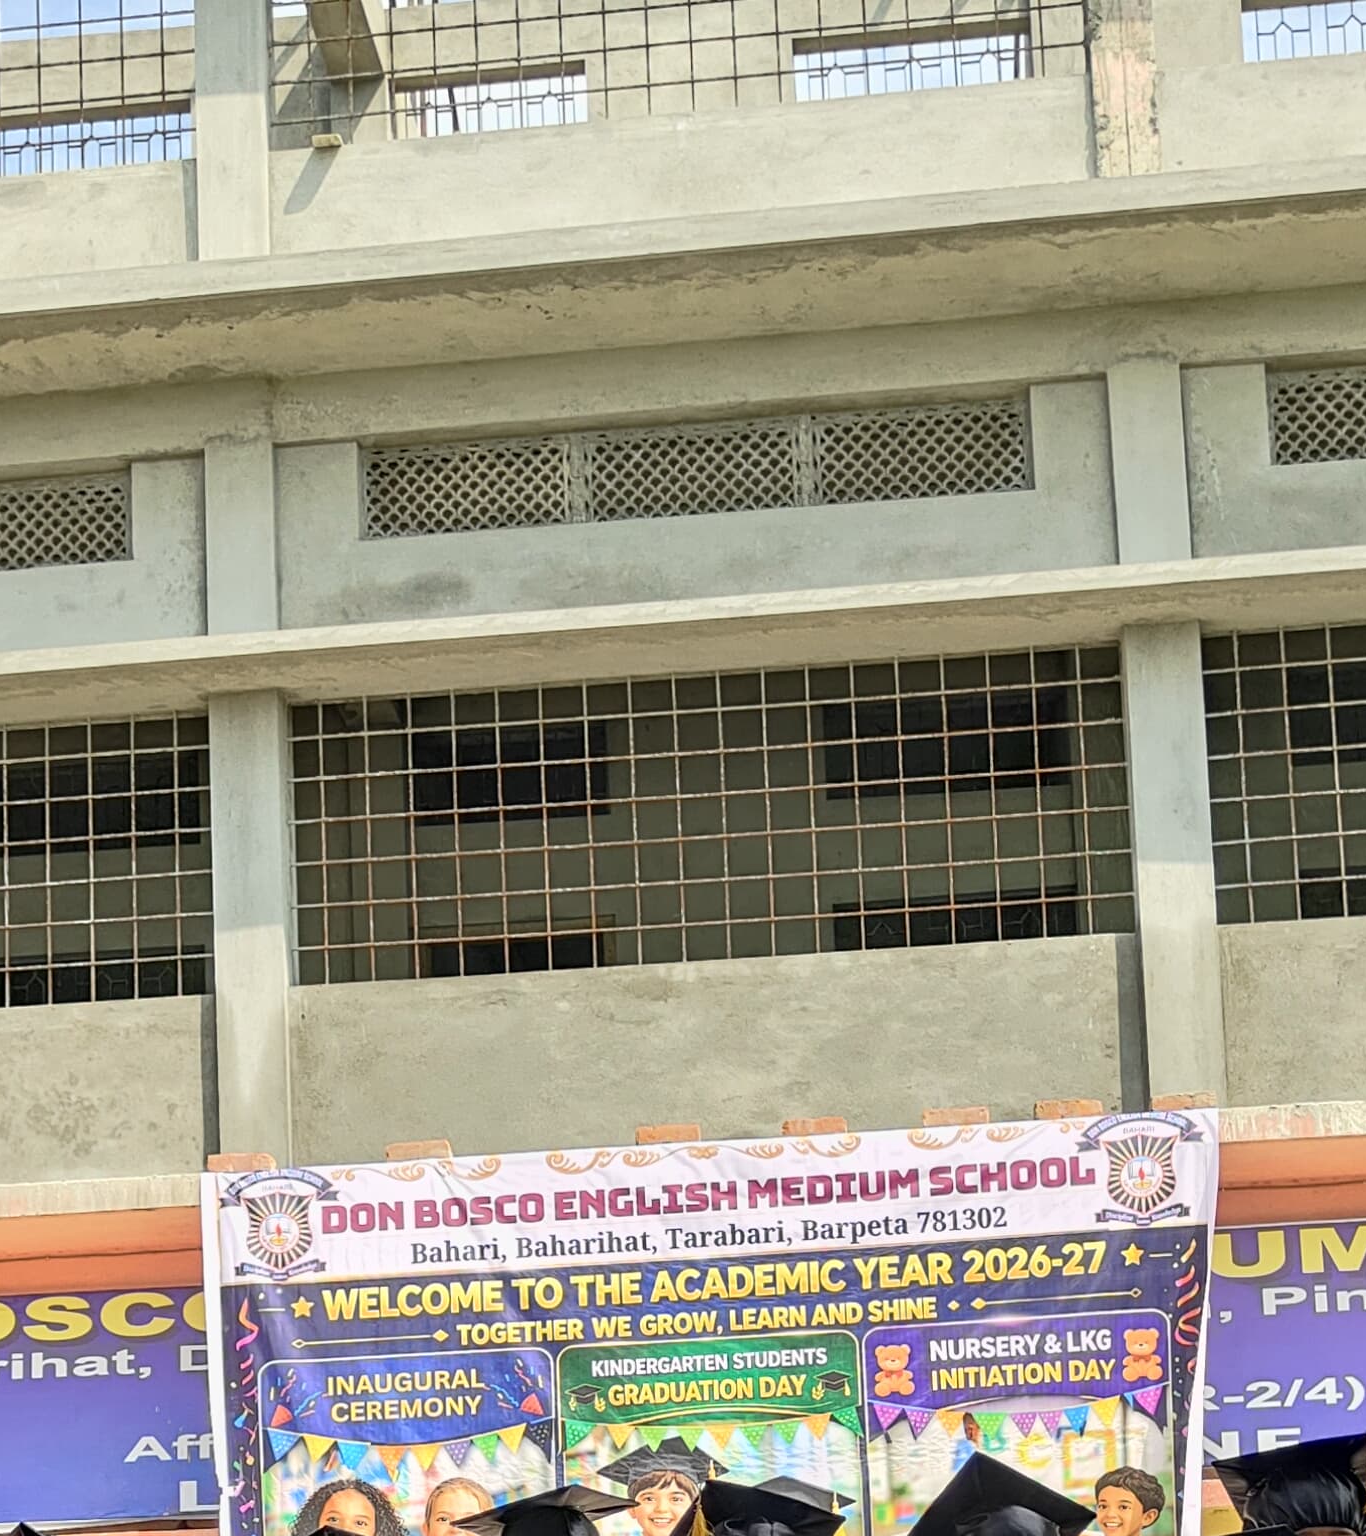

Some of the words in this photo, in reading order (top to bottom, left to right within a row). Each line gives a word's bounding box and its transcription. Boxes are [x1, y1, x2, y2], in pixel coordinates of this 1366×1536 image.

[321, 1200, 405, 1235] DON
[414, 1193, 544, 1229] BOSCO
[554, 1181, 738, 1222] ENGLISH
[747, 1167, 920, 1210] MEDIUM
[929, 1156, 1096, 1196] SCHOOL
[411, 1238, 507, 1265] Bahari,
[515, 1231, 658, 1259] Baharihat,
[665, 1220, 793, 1249] Tarabari,
[802, 1215, 909, 1244] Barpeta
[916, 1206, 1008, 1234] 781302
[322, 1280, 505, 1321] WELCOME
[511, 1281, 563, 1310] TO
[570, 1272, 643, 1307] THE
[650, 1259, 846, 1303] ACADEMIC
[854, 1253, 953, 1290] YEAR
[962, 1241, 1107, 1284] 2026-27
[456, 1320, 583, 1346] TOGETHER
[592, 1316, 632, 1338] WE
[641, 1311, 723, 1337] GROW,
[729, 1306, 807, 1332] LEARN
[811, 1301, 863, 1326] AND
[867, 1297, 938, 1323] SHINE
[929, 1333, 1040, 1361] NURSERY
[1044, 1333, 1062, 1354] &
[1067, 1329, 1112, 1353] LKG
[591, 1353, 729, 1377] KINDERGARTEN
[733, 1348, 828, 1369] STUDENTS
[931, 1362, 1061, 1391] INITIATION
[1069, 1359, 1116, 1382] DAY
[327, 1369, 485, 1397] INAUGURAL
[608, 1379, 754, 1407] GRADUATION
[759, 1374, 806, 1400] DAY
[331, 1394, 483, 1423] CEREMONY
